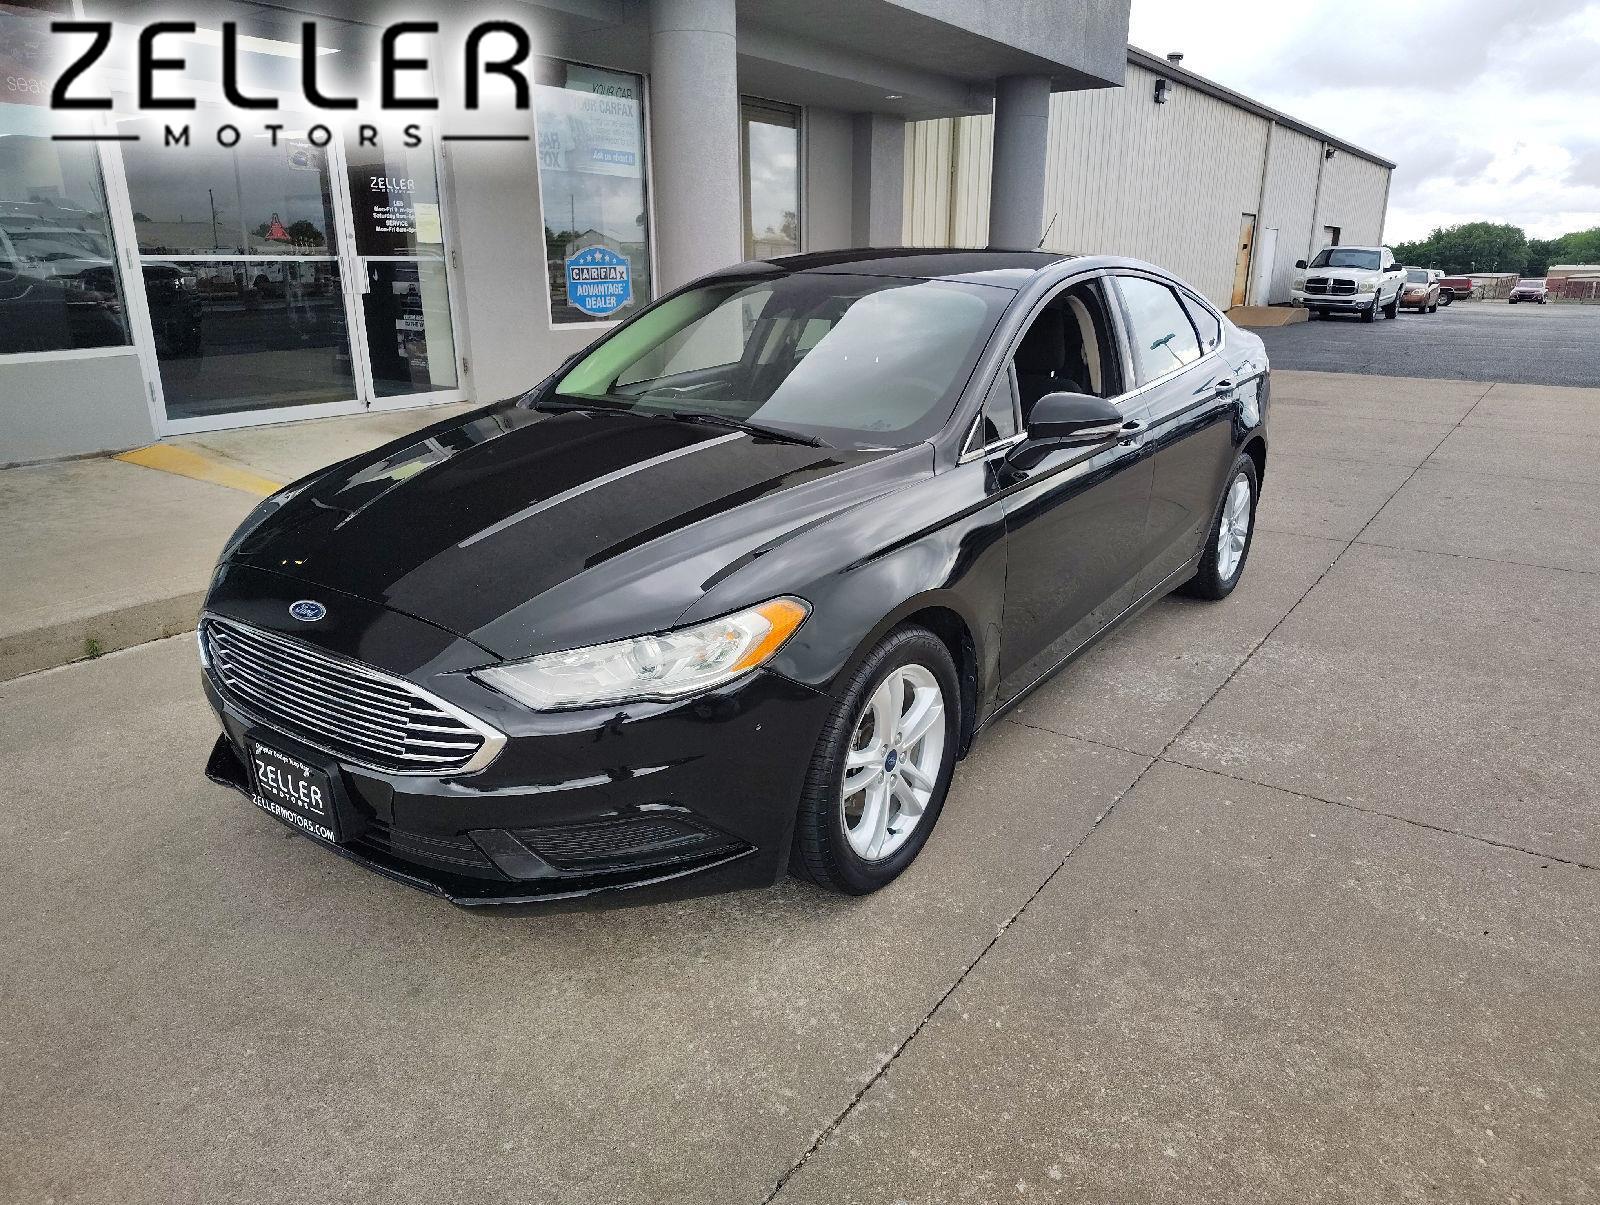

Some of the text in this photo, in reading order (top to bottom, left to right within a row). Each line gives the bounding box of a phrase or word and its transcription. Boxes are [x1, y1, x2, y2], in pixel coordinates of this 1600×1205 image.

[599, 99, 634, 117] CARFAX
[370, 177, 415, 189] ZELLER
[571, 267, 626, 281] CARFAX
[576, 283, 624, 297] ADVANTAGE
[585, 297, 617, 309] DEALER
[294, 603, 319, 617] Ford
[255, 758, 323, 809] ZELLER
[252, 793, 336, 843] ZELLERMOTORS.COM
